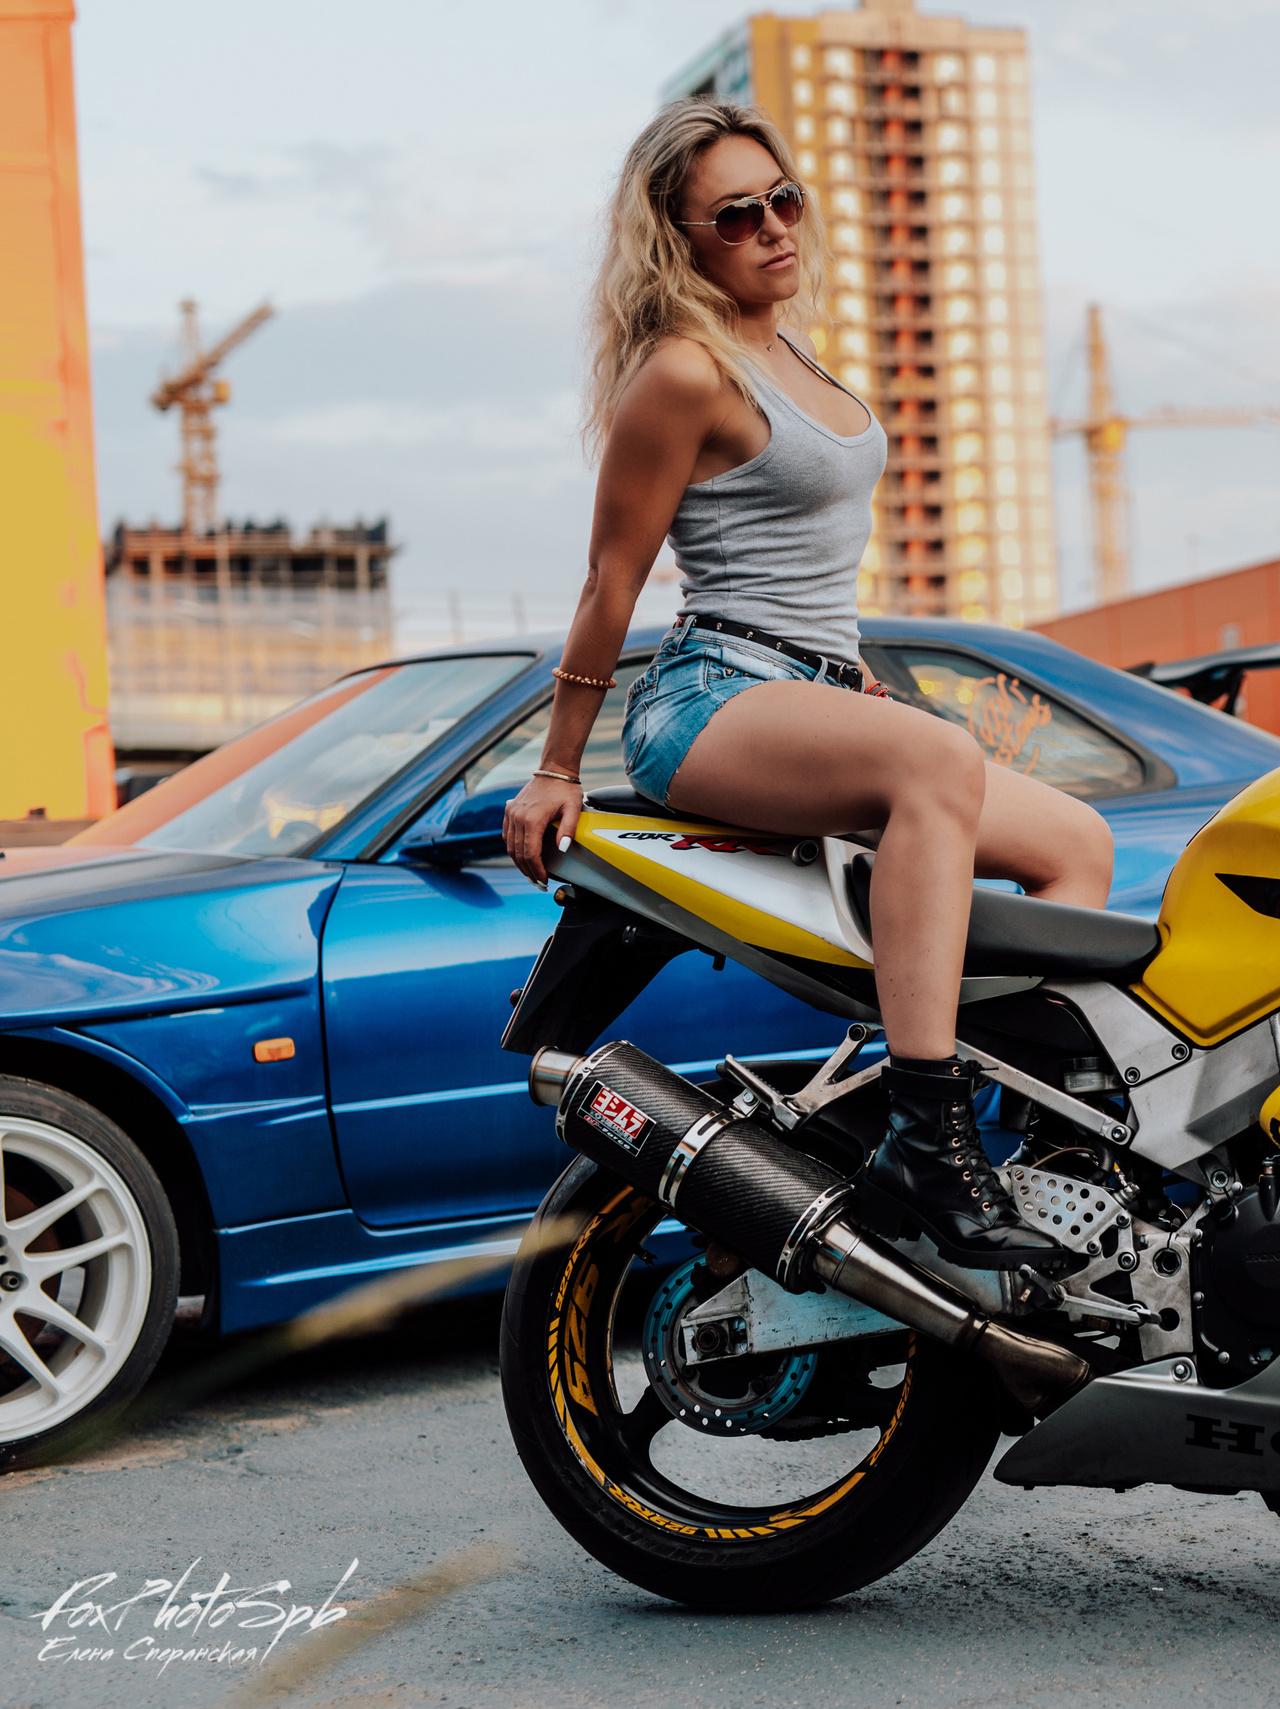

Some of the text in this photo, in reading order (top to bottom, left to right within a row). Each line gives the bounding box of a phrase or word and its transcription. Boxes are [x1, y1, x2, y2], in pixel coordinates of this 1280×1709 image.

[618, 832, 676, 842] CBR
[593, 1089, 645, 1134] ヨシムラ
[555, 1214, 603, 1312] 929RR
[866, 1368, 914, 1467] 929RR
[608, 1482, 700, 1535] 929RR
